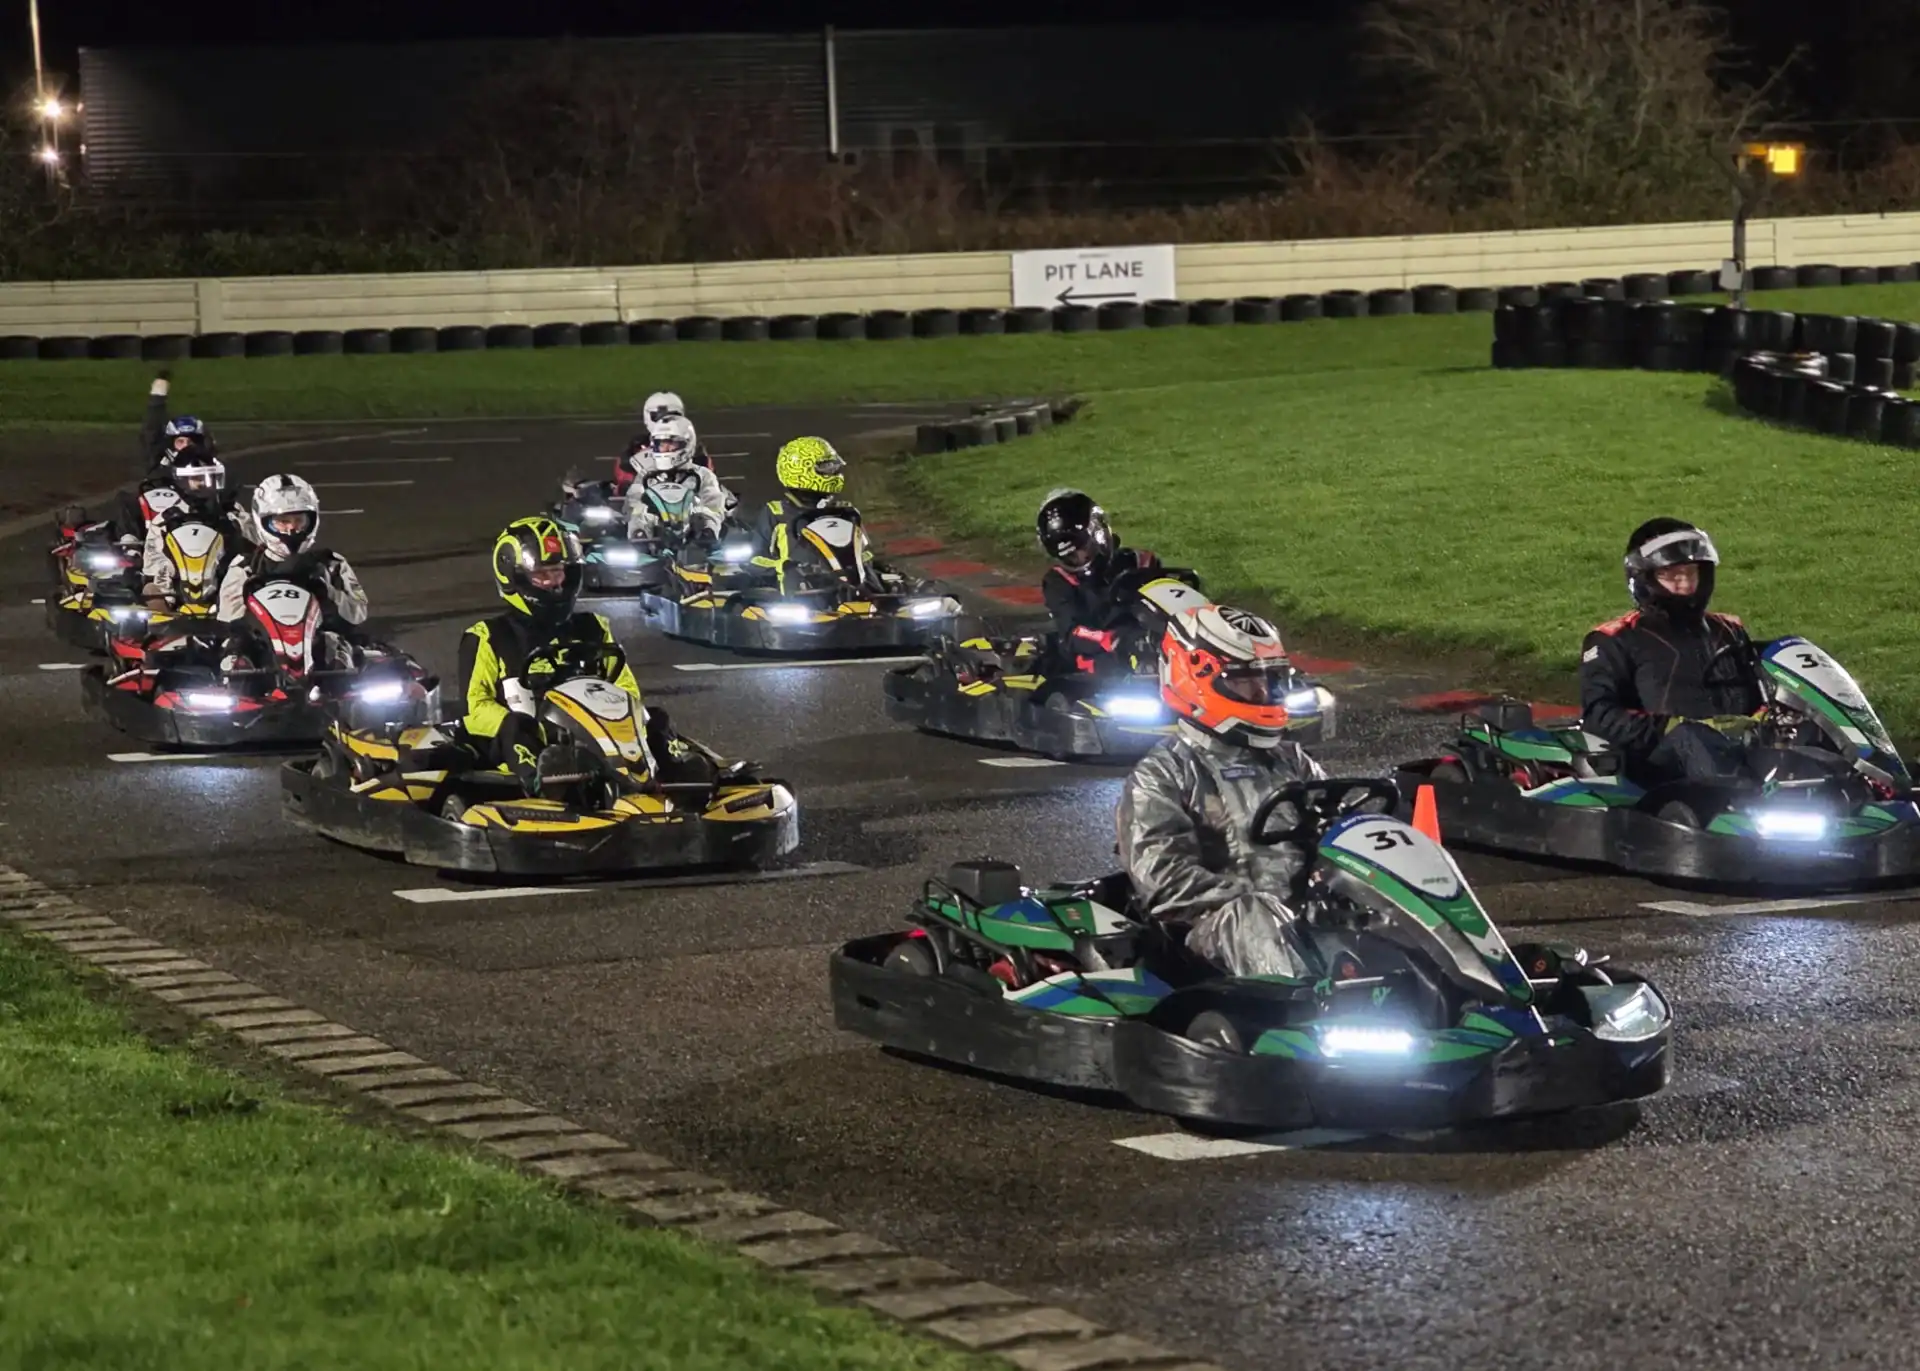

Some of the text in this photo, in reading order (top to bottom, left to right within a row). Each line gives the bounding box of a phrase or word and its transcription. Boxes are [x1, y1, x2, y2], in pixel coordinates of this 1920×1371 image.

[1045, 261, 1144, 281] PIT LANE
[267, 589, 300, 600] 28
[1364, 829, 1415, 851] 31
